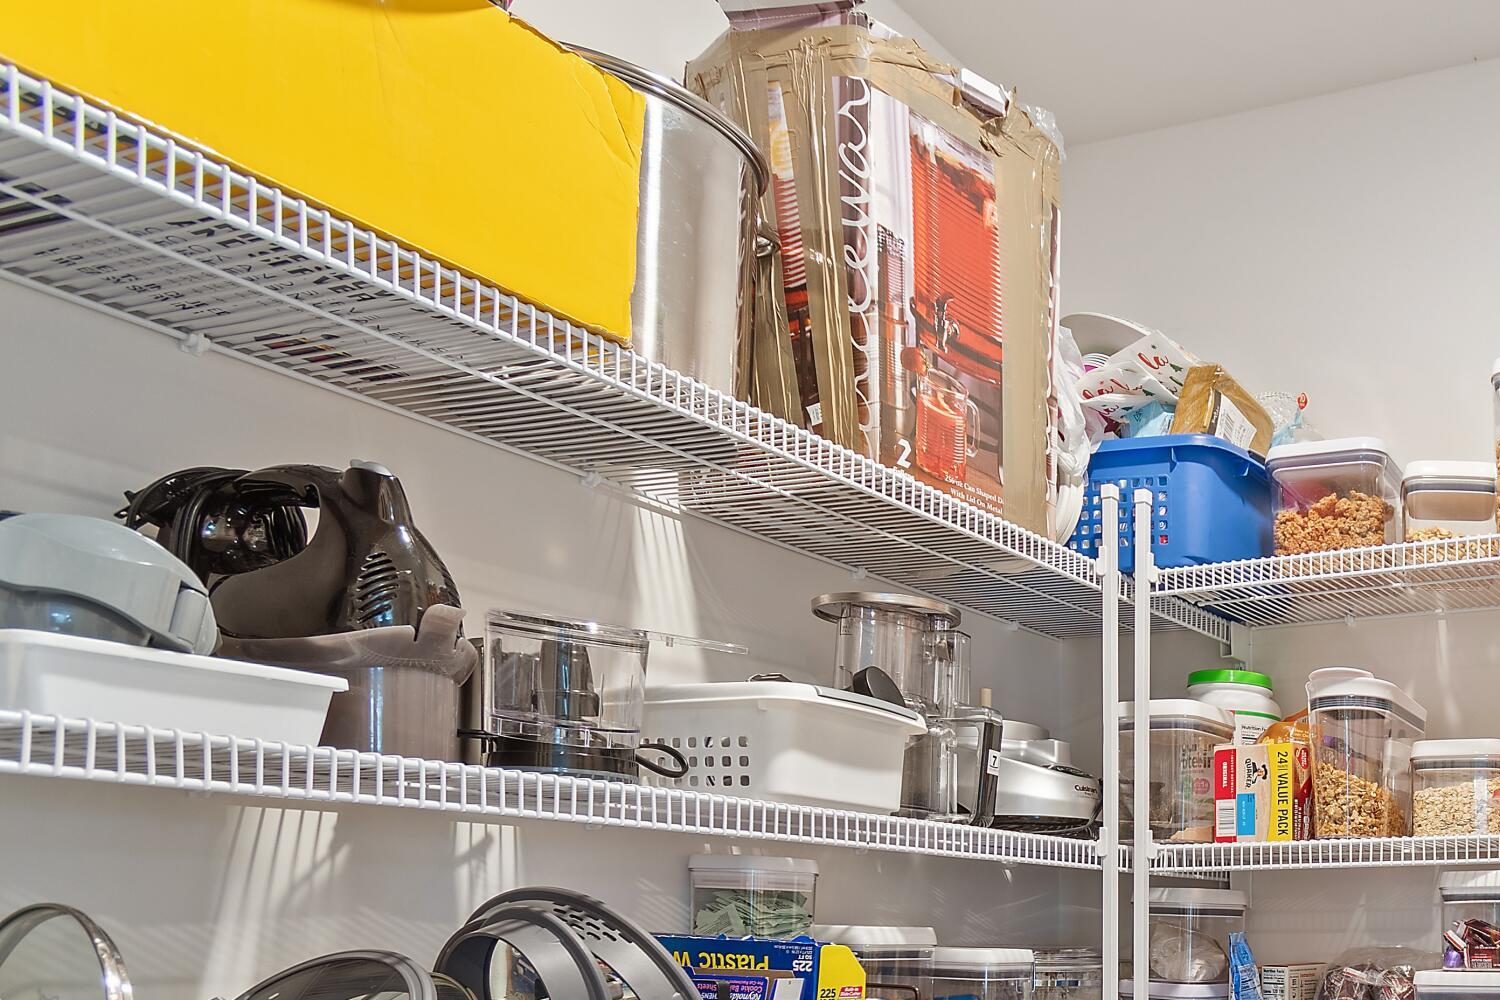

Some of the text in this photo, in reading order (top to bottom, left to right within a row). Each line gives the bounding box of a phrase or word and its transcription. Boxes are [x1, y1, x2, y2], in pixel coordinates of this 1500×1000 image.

[896, 439, 911, 468] 2
[1244, 758, 1252, 789] QUAKER
[1277, 751, 1288, 836] 24 VALUE PACK
[698, 951, 769, 970] Plastic
[793, 961, 812, 972] 225
[741, 984, 763, 994] Cookie
[820, 988, 836, 999] 225
